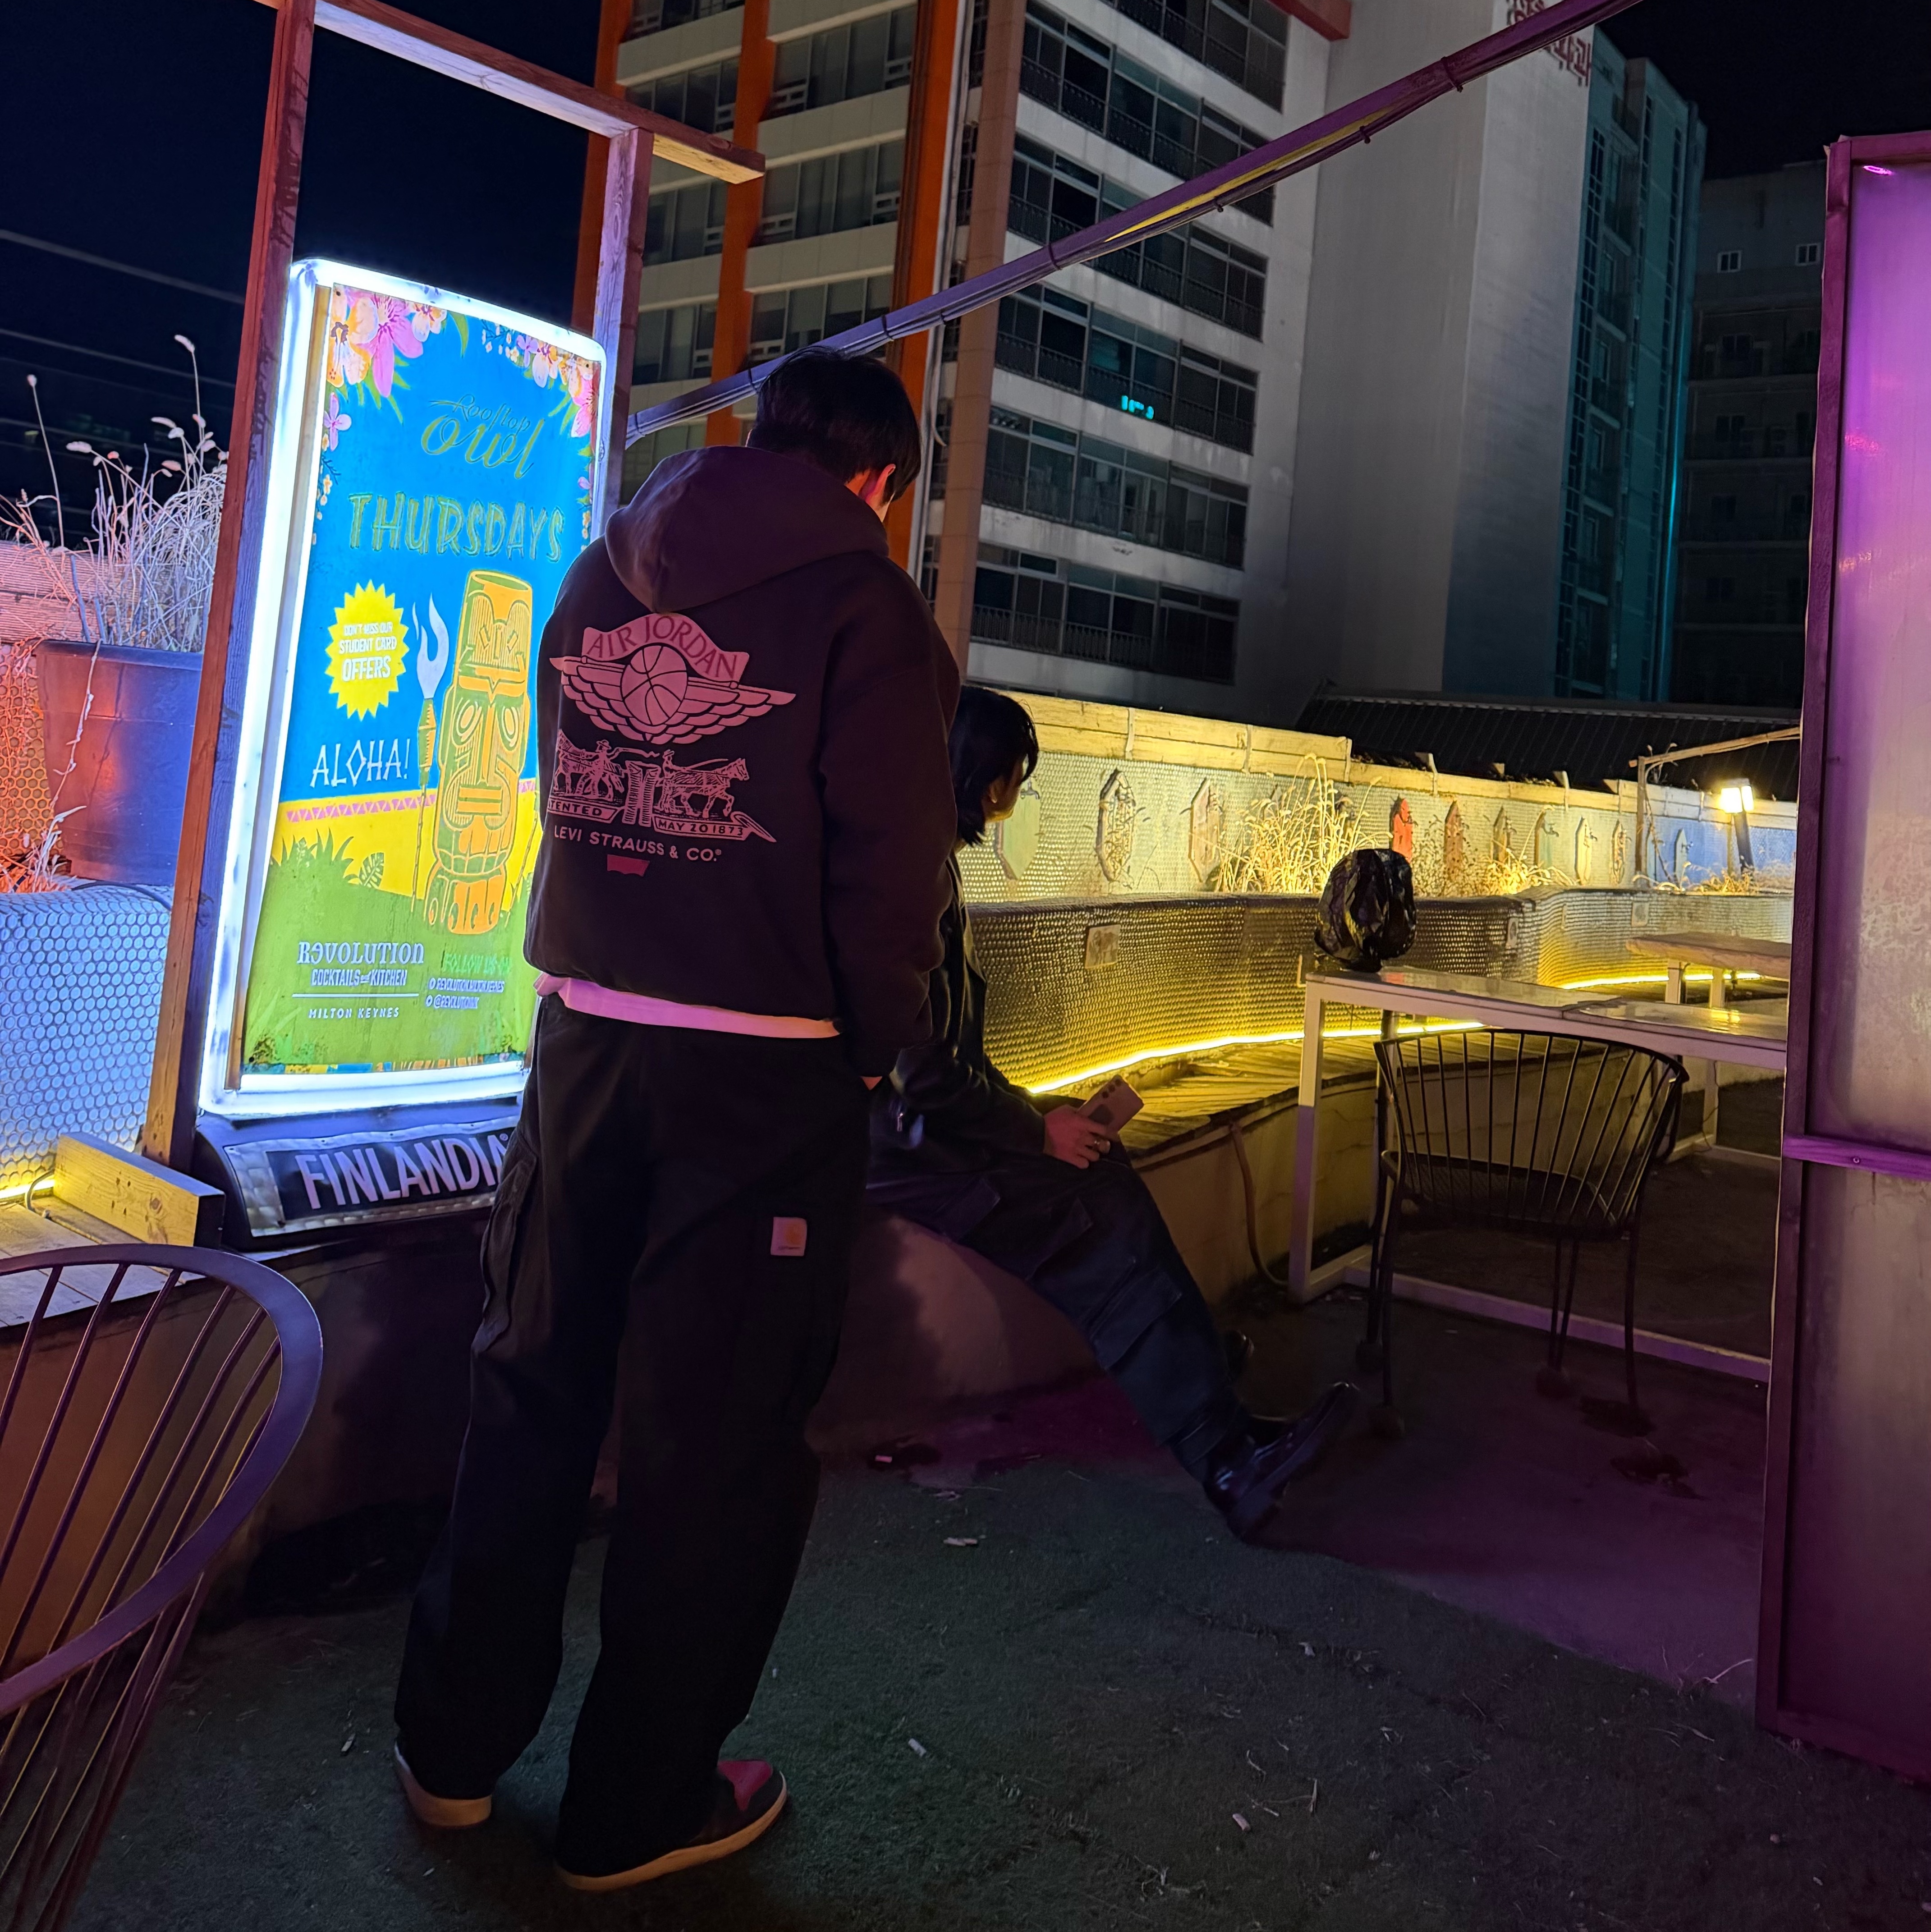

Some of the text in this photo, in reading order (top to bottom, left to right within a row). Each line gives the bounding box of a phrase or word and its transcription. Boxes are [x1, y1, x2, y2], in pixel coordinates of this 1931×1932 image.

[348, 491, 564, 563] THURSDAYS
[339, 636, 397, 654] STUDENT CARD
[587, 615, 737, 679] AIR JORDAN
[342, 655, 391, 681] OFFERS
[310, 738, 410, 788] ALOHA!
[549, 800, 743, 836] TENTED MAY 20 1873
[554, 825, 582, 842] LEVI
[589, 831, 665, 855] STRAUSS
[669, 845, 679, 859] &
[297, 941, 424, 964] REVOLUTION
[312, 969, 361, 987] COCKTAILS
[370, 969, 407, 986] KITCHEN
[308, 1007, 399, 1019] MILTON KEYNES
